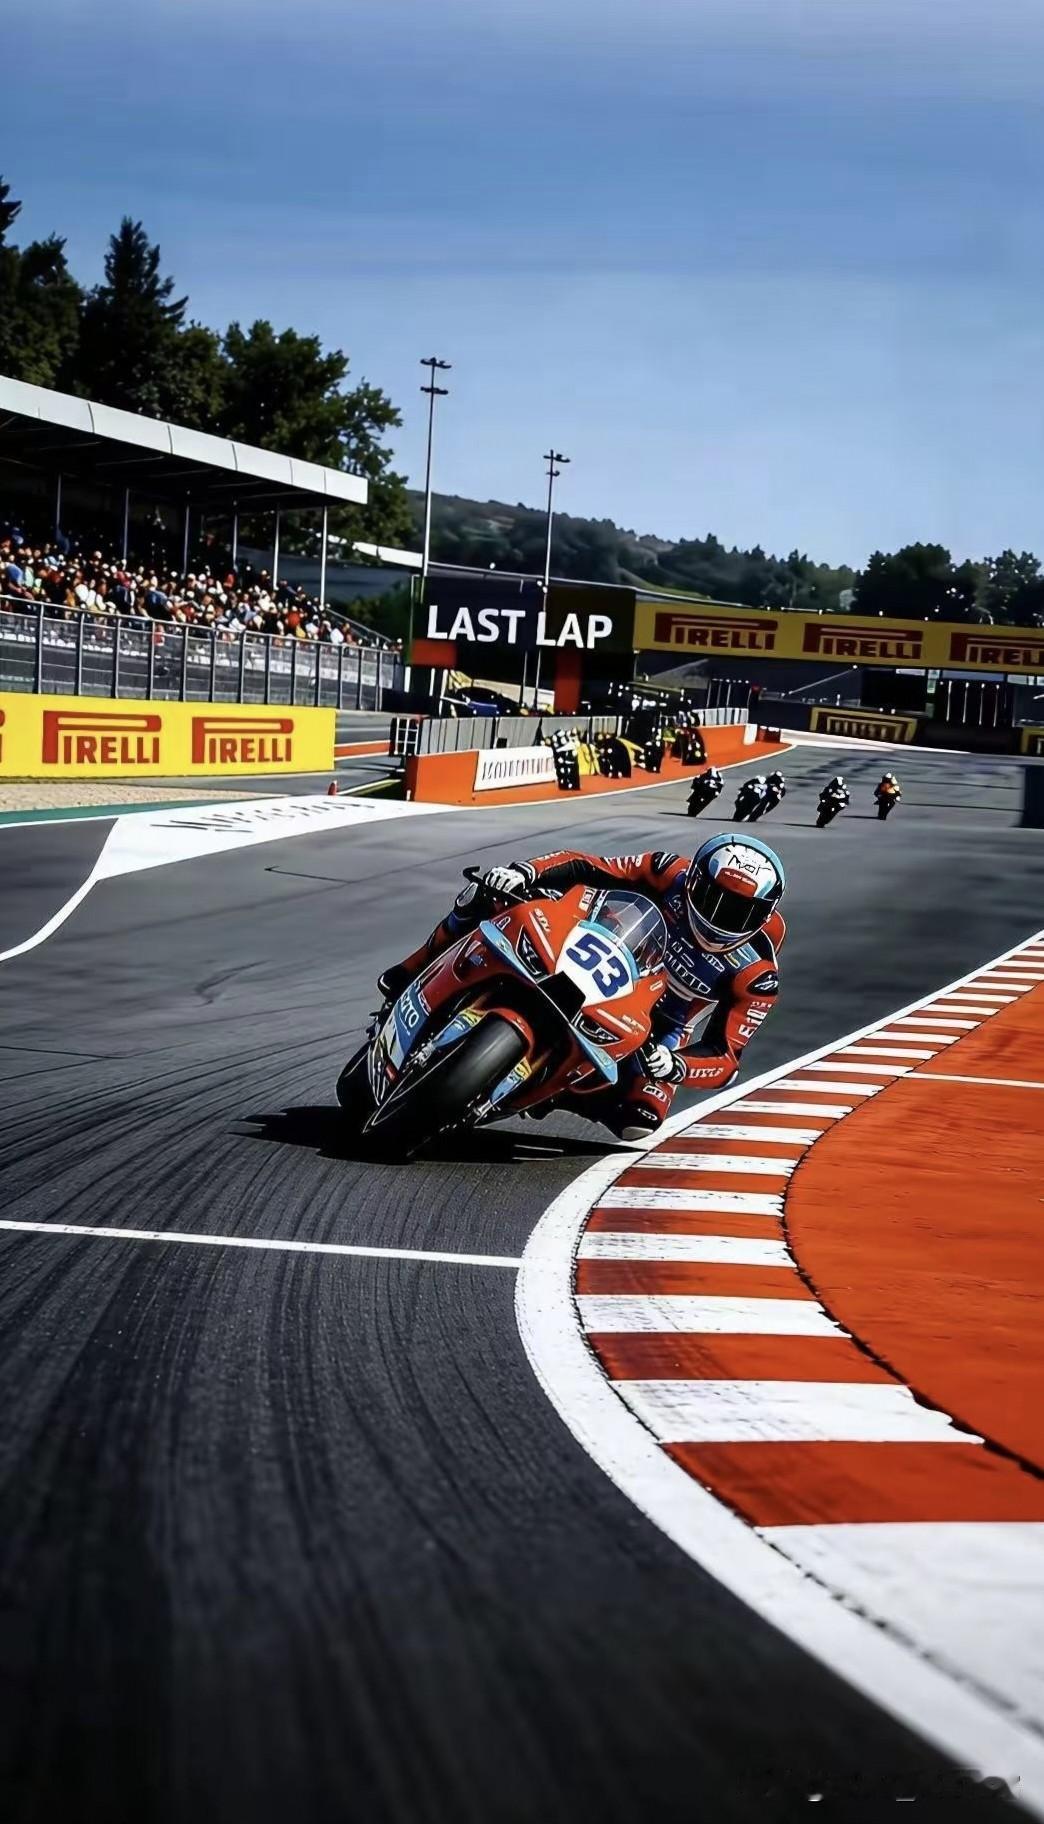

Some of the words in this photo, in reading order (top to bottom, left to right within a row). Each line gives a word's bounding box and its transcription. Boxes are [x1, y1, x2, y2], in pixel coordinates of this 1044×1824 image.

[427, 605, 525, 644] LAST
[536, 611, 613, 649] LAP
[654, 612, 778, 650] PIRELLI
[803, 622, 924, 660] PIRELLI
[42, 710, 162, 764] PIRELLI
[191, 717, 294, 764] PIRELLI
[565, 933, 629, 998] 53
